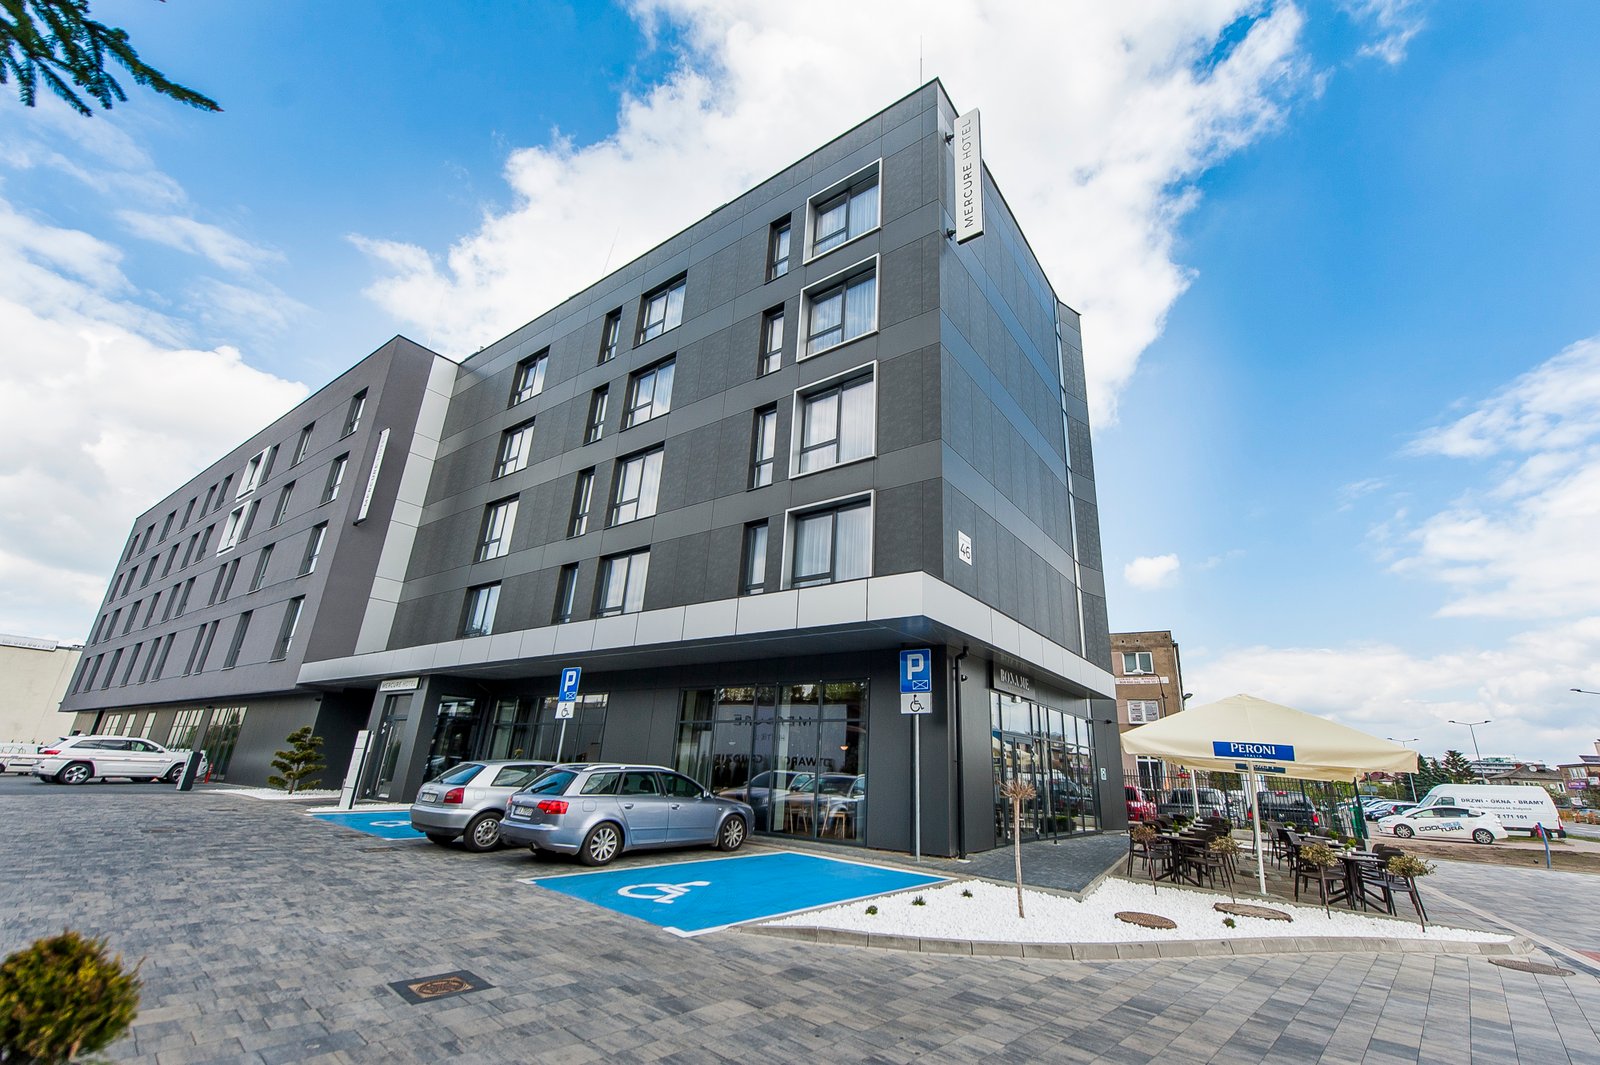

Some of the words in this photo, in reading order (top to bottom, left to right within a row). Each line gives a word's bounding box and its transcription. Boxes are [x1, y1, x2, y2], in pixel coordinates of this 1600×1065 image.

[961, 119, 972, 160] HOTEL
[963, 162, 974, 228] MERCURE
[960, 543, 970, 559] 46
[907, 653, 924, 680] P
[563, 670, 577, 692] P
[1230, 743, 1276, 755] PERONI
